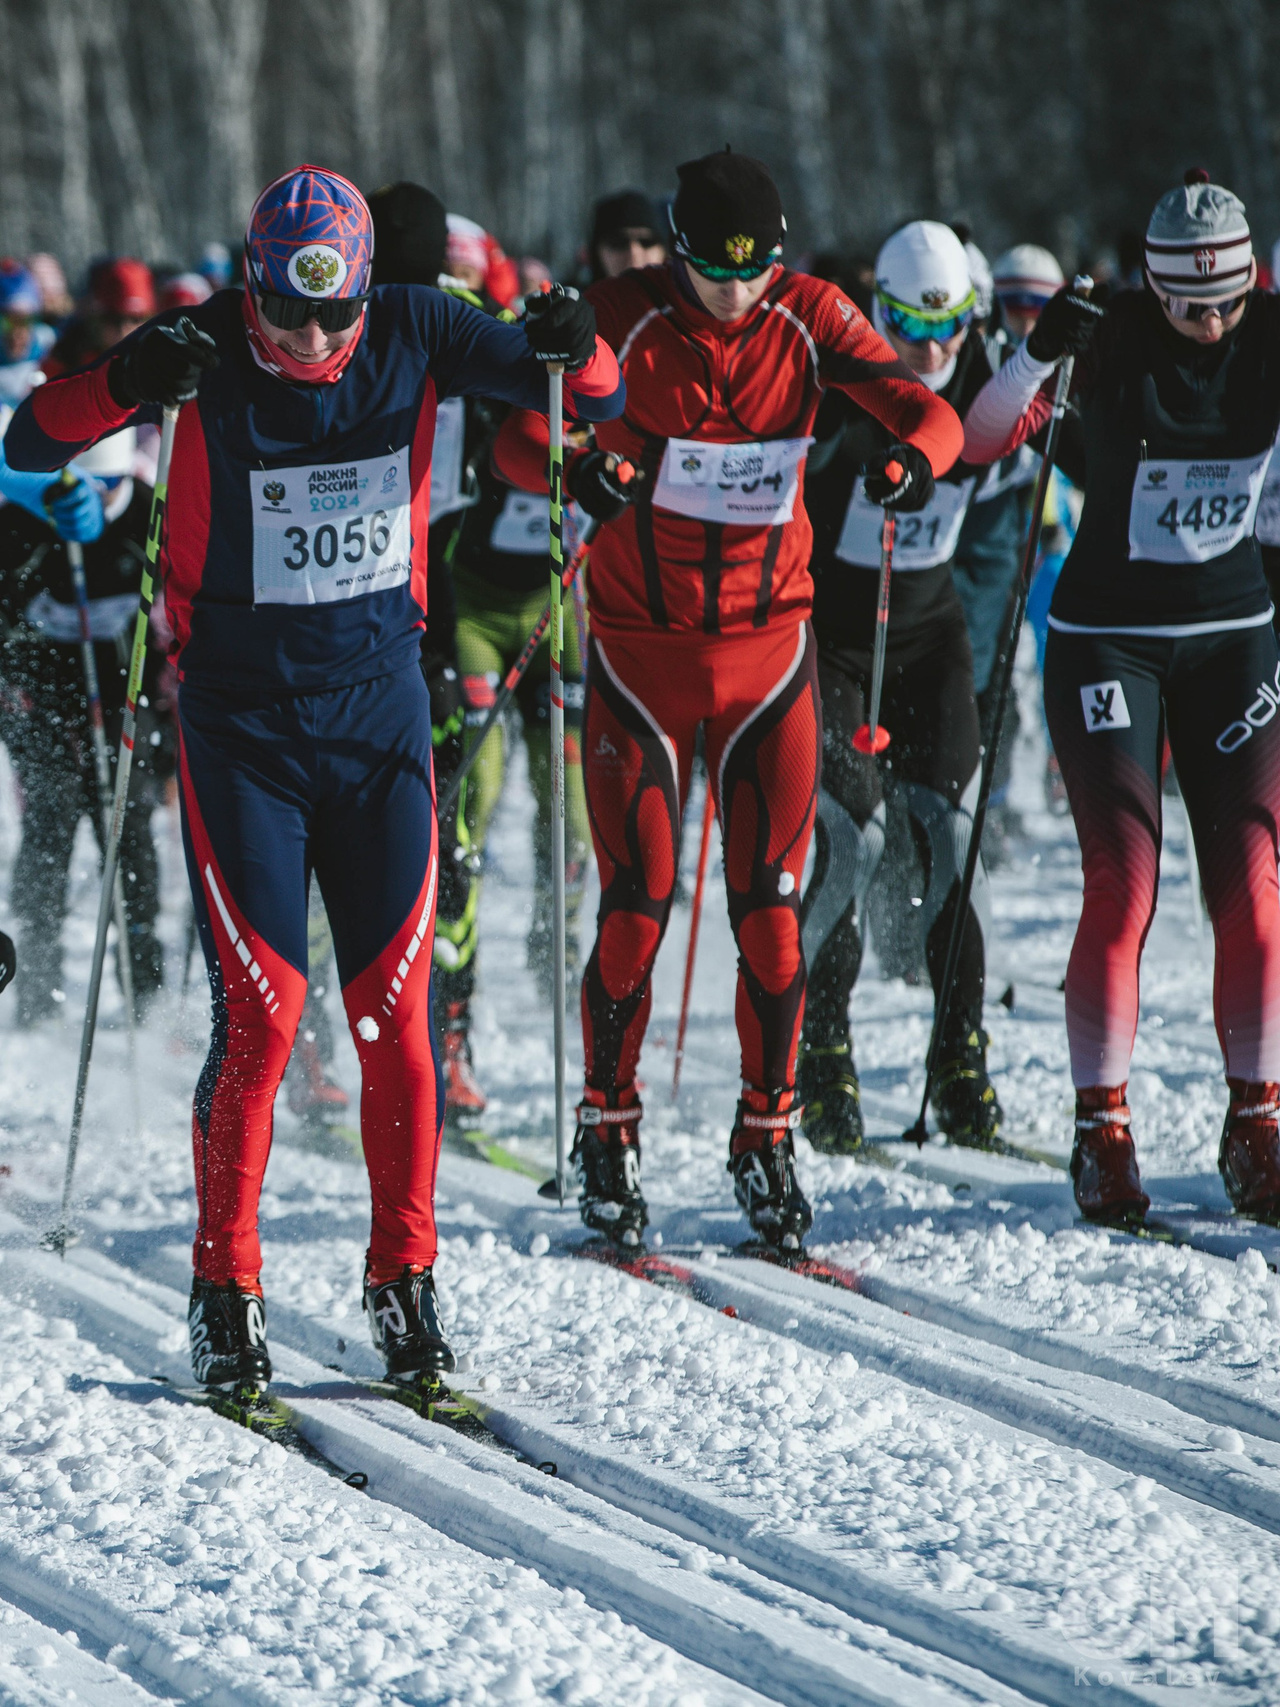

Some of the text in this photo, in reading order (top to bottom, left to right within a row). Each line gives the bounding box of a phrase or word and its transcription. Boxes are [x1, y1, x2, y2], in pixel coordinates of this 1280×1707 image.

[307, 467, 357, 483] ЛЫЖНЯ
[309, 479, 358, 495] РОССИИ
[309, 494, 360, 512] 2024
[1157, 494, 1251, 536] 4482
[283, 509, 391, 571] 3056
[335, 572, 376, 587] ИРКУСКАЯ
